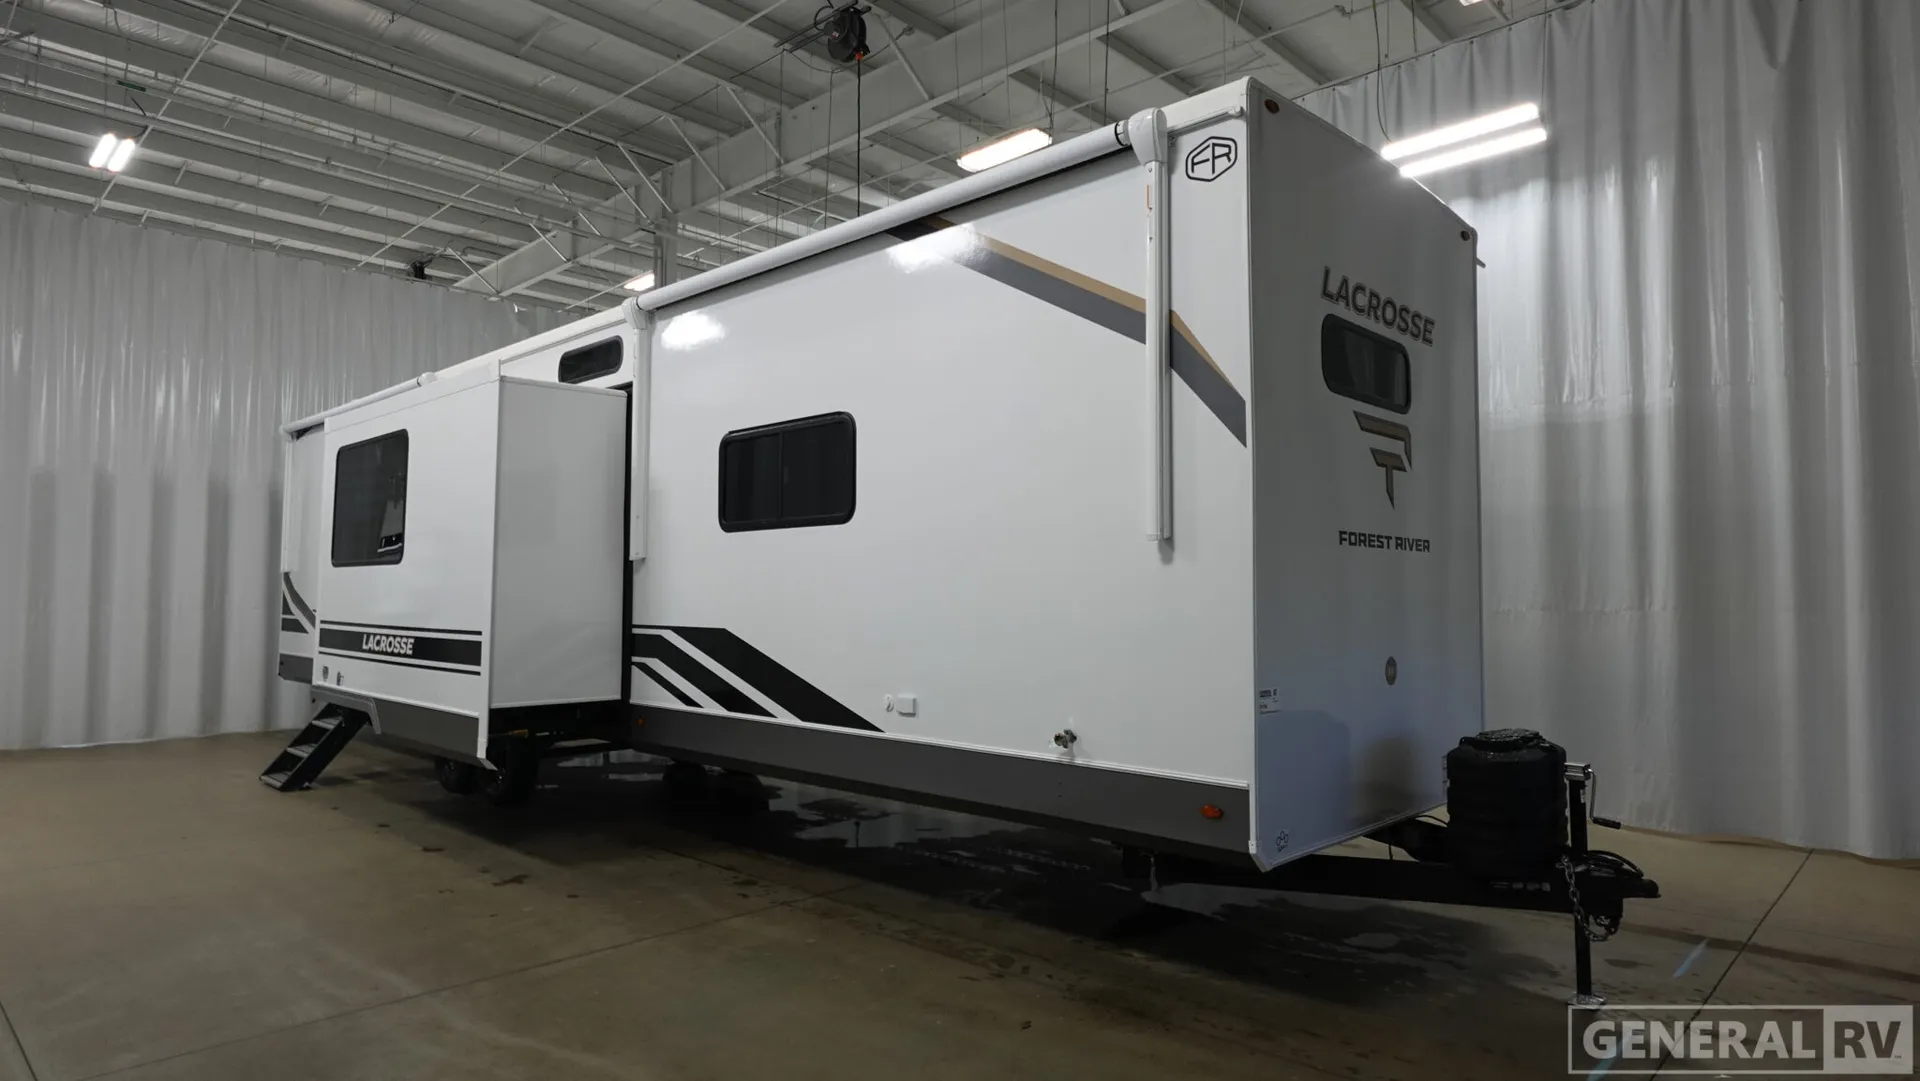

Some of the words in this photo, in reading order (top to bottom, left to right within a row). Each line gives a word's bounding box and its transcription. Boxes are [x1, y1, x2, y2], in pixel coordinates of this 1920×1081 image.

[1191, 143, 1232, 174] FR
[1321, 266, 1435, 346] LACROSSE
[1338, 530, 1393, 549] FOREST
[1395, 536, 1430, 552] RIVER
[362, 634, 414, 655] LACROSSE
